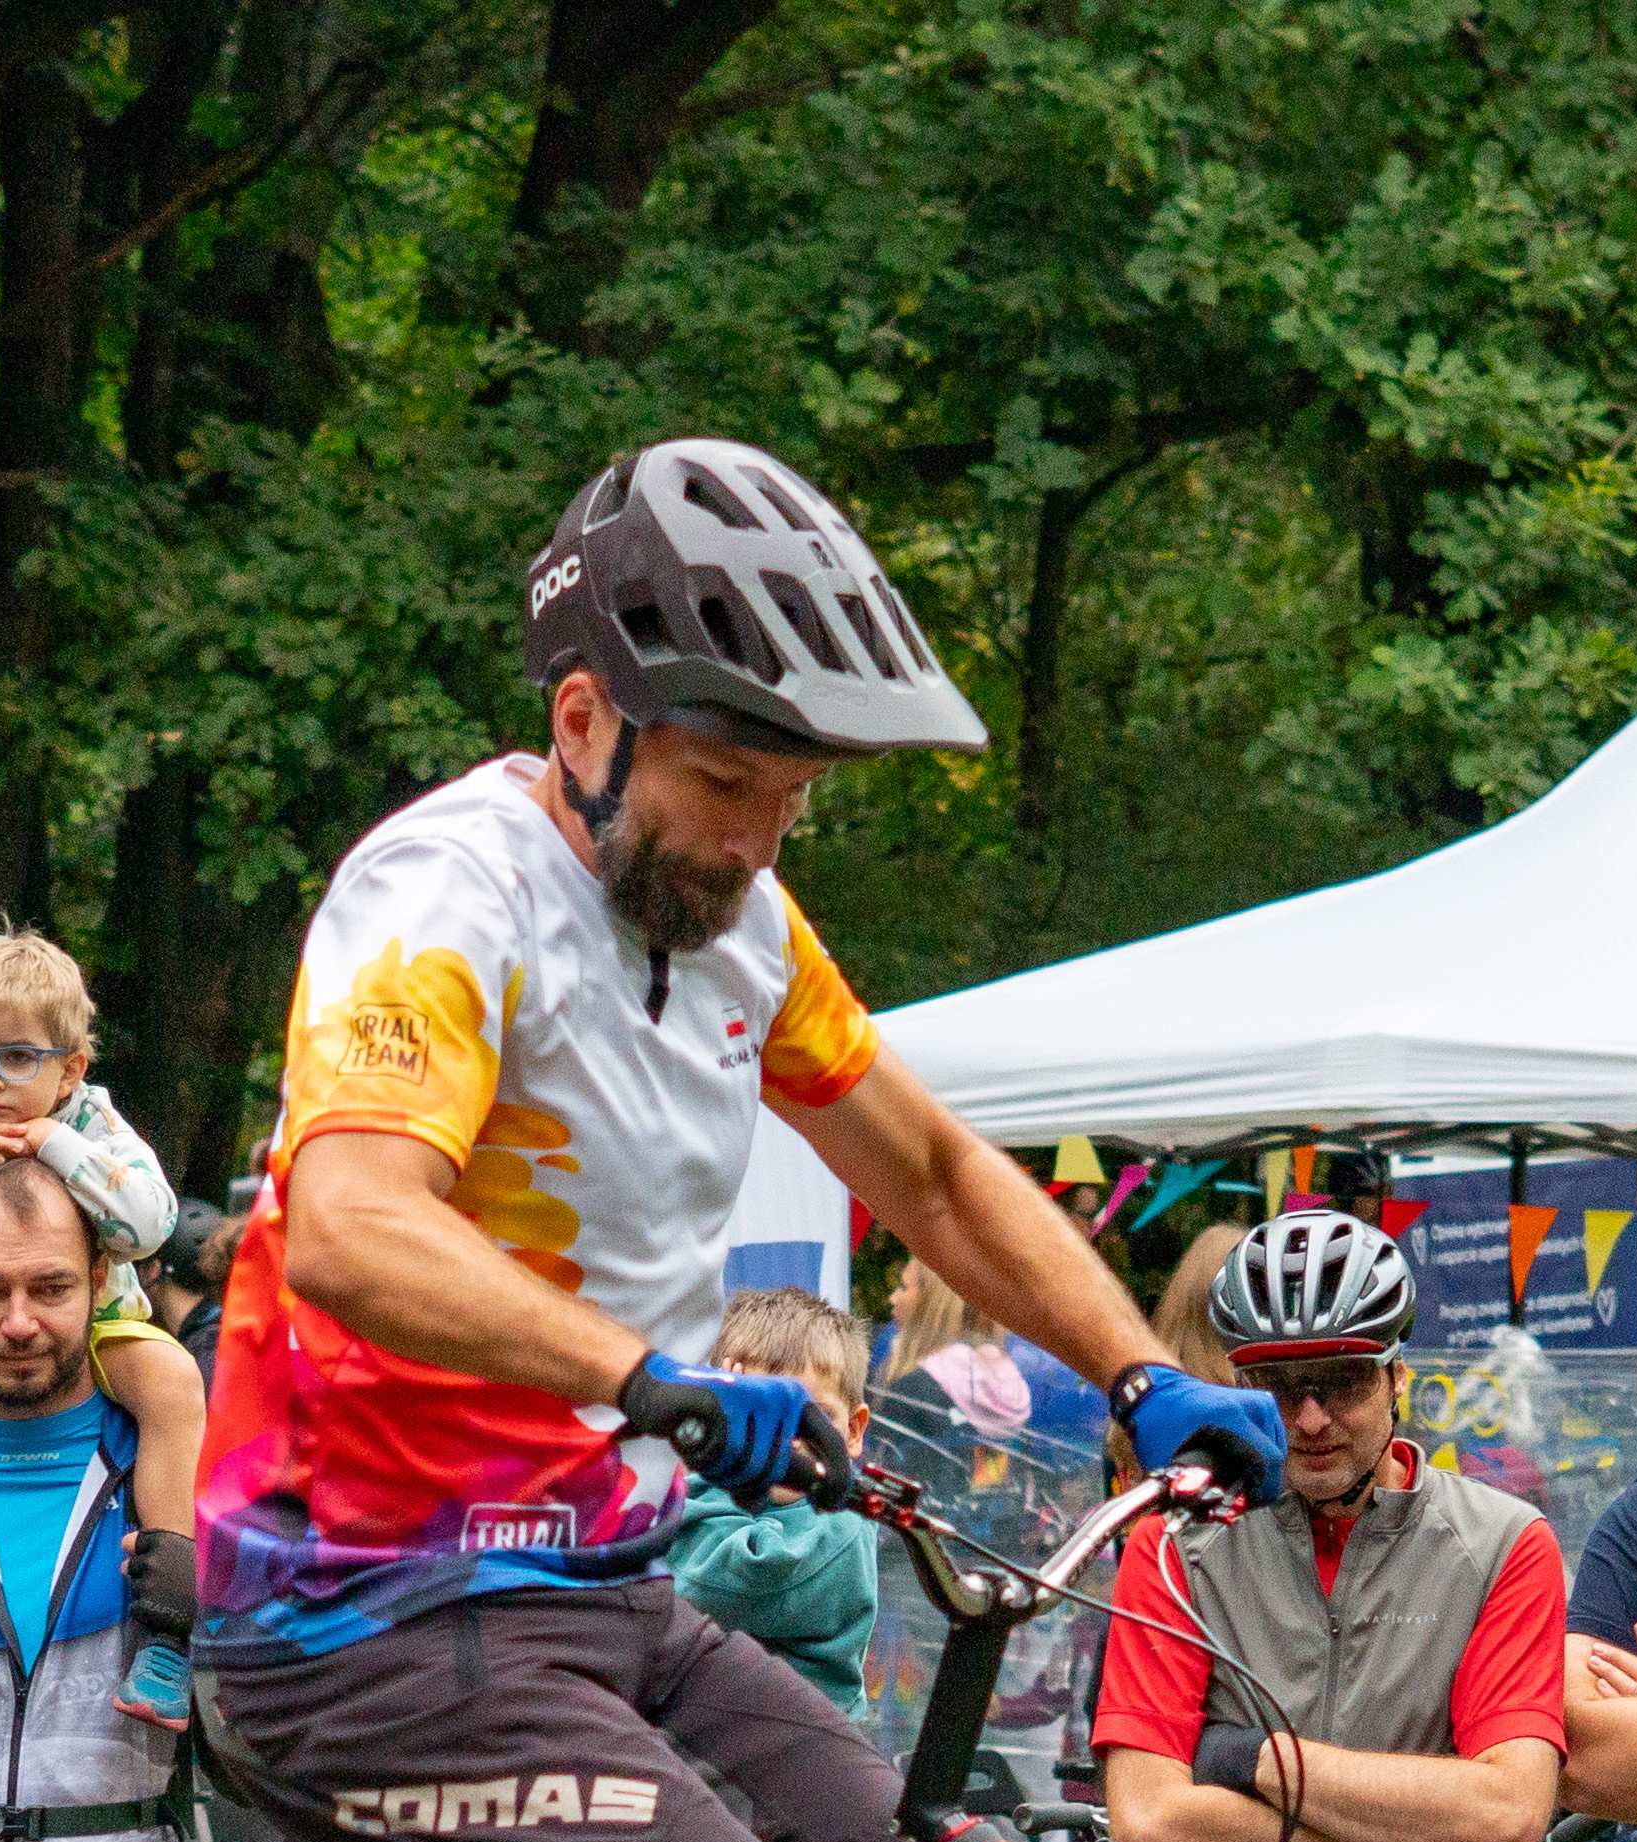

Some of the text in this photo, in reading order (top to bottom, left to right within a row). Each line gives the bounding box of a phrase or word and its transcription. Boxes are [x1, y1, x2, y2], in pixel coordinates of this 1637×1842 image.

[354, 1014, 420, 1044] TRIAL
[353, 1042, 418, 1074] TEAM
[332, 1774, 659, 1836] COMAS
